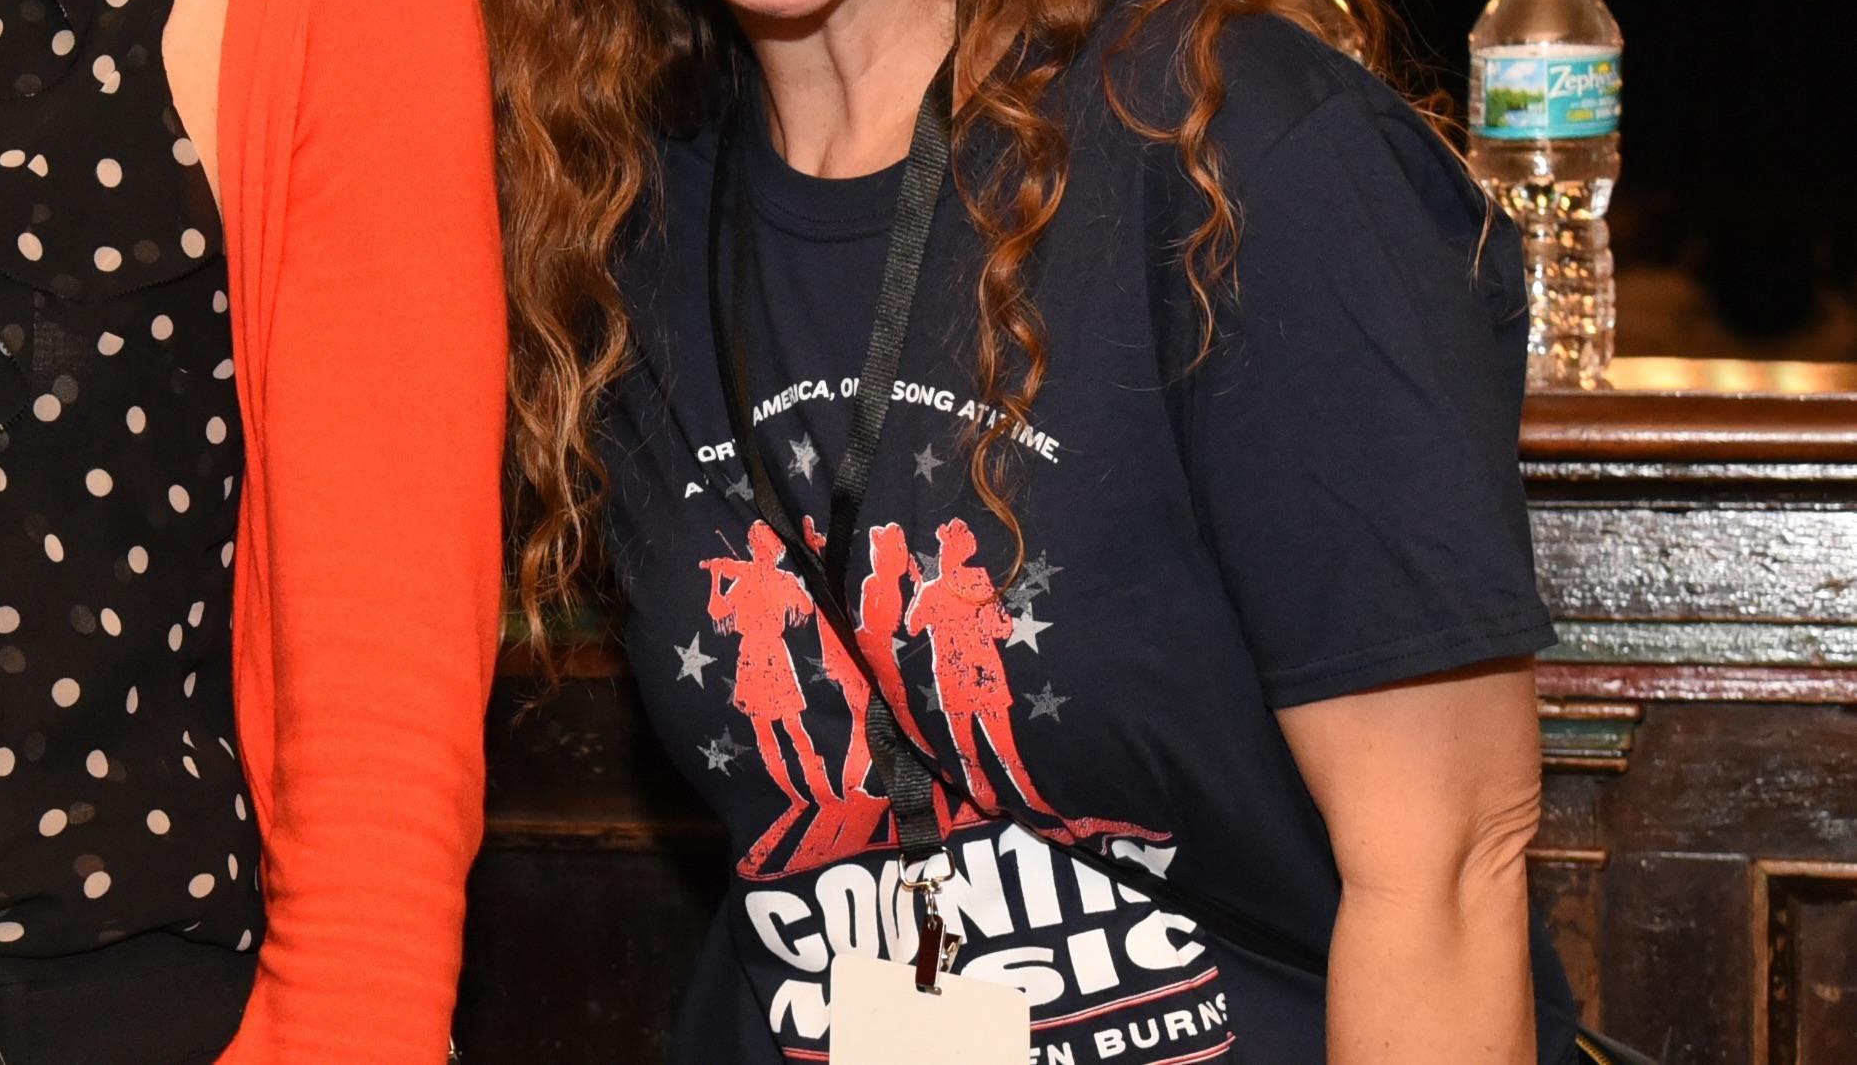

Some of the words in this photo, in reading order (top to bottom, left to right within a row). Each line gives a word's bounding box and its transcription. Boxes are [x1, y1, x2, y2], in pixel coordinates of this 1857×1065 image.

[683, 481, 704, 499] A
[752, 379, 836, 428] AMERICA,
[891, 379, 956, 413] SONG
[956, 398, 990, 421] AT
[1003, 417, 1060, 464] IME.
[769, 909, 1207, 1040] MSIC
